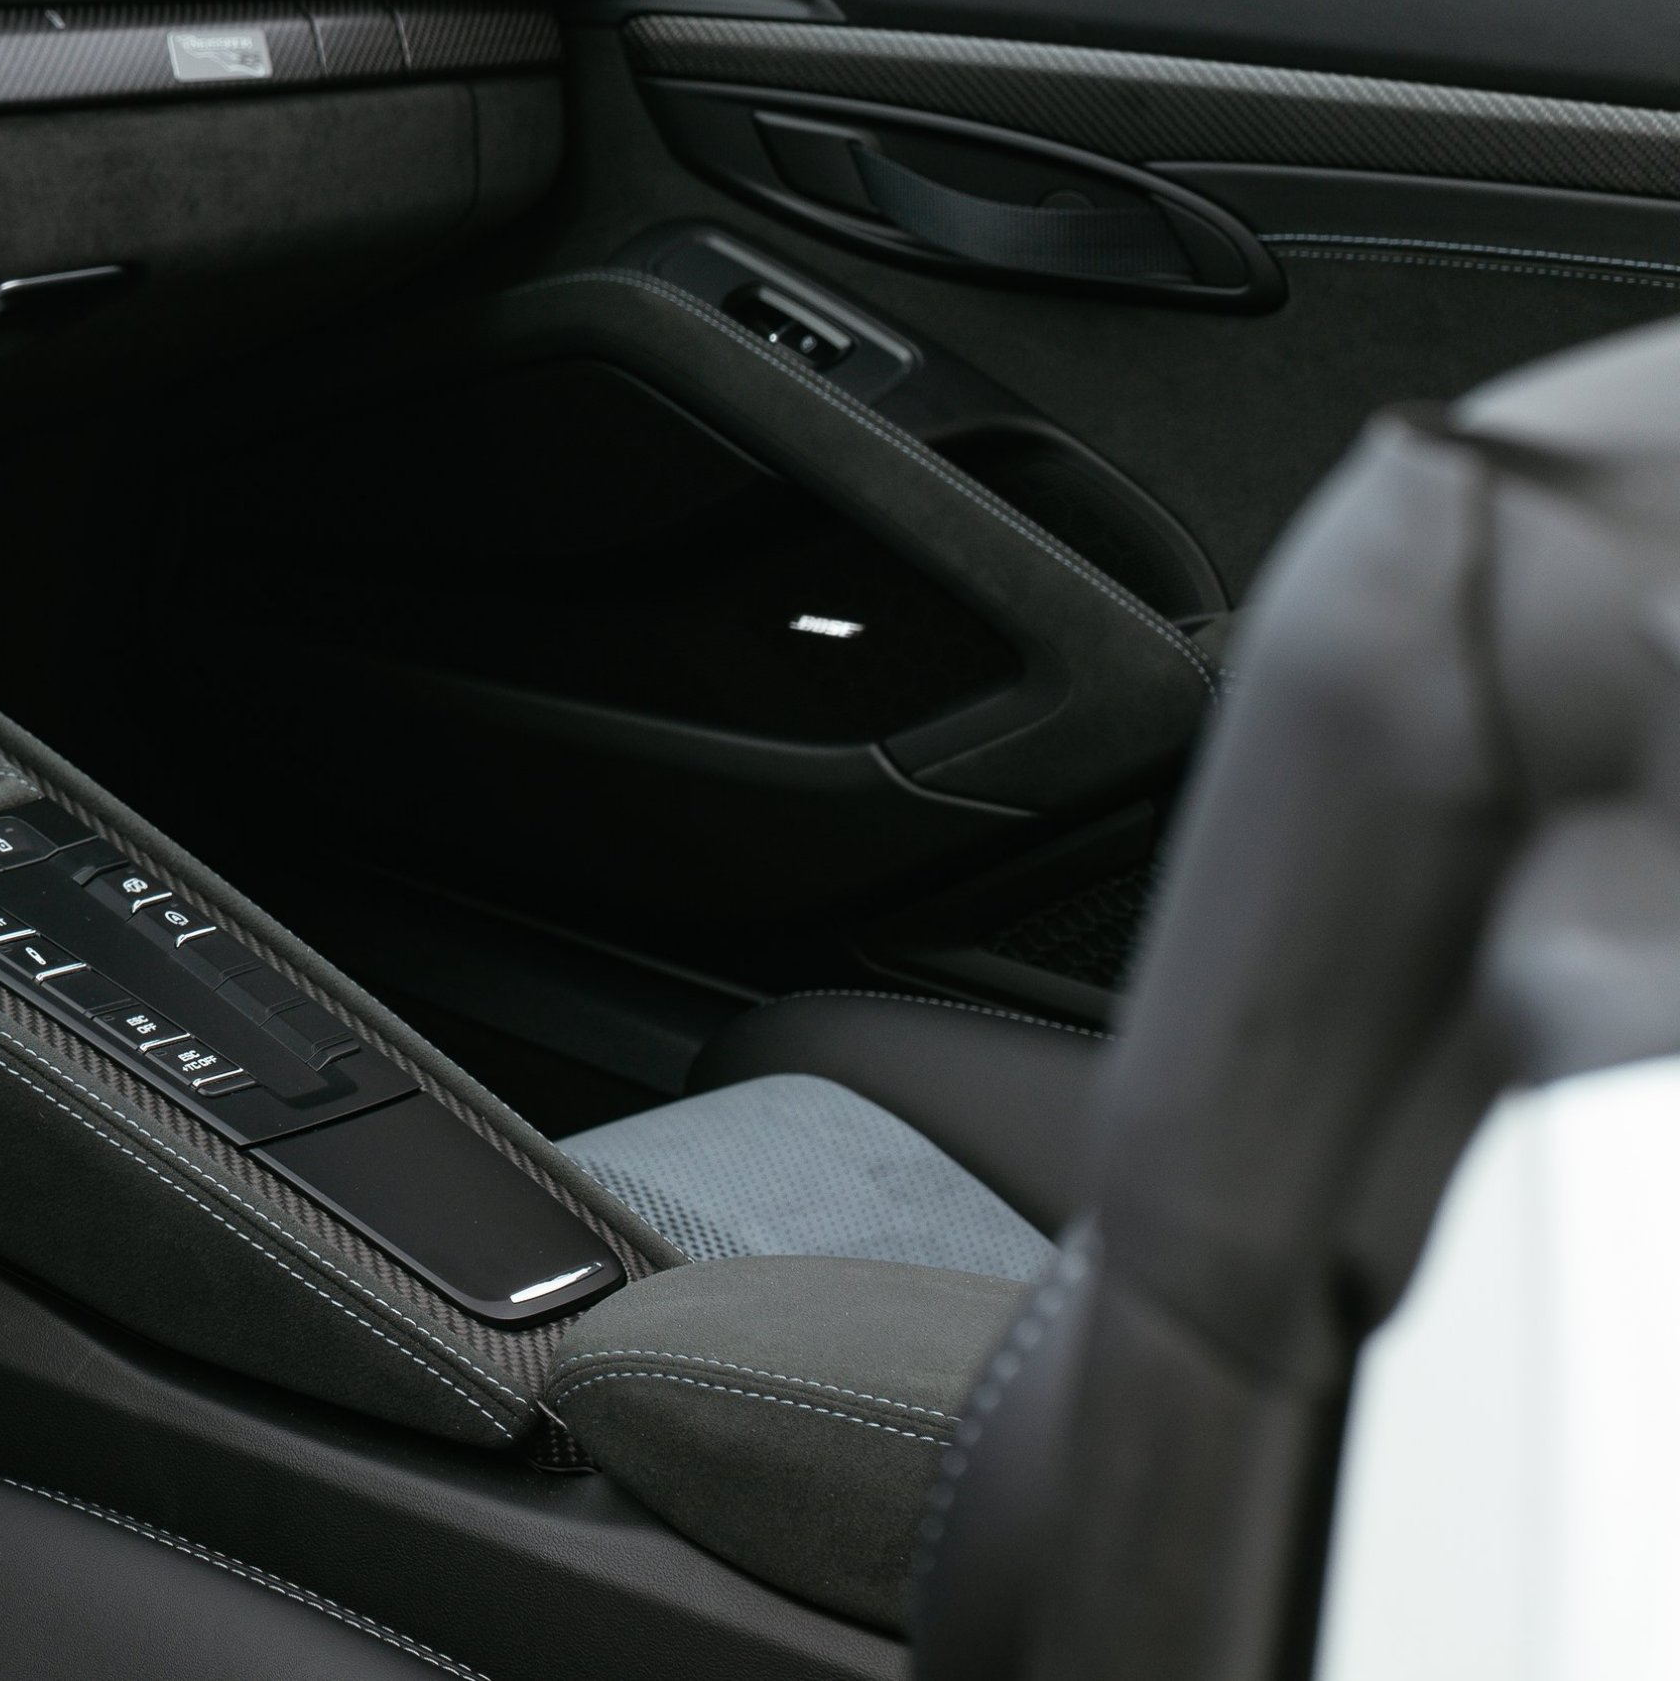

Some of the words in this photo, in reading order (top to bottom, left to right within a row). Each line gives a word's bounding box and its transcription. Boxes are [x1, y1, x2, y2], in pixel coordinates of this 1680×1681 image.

[126, 1015, 149, 1027] ESC
[136, 1022, 157, 1034] OFF
[177, 1050, 200, 1062] ESC
[198, 1054, 218, 1068] OFF
